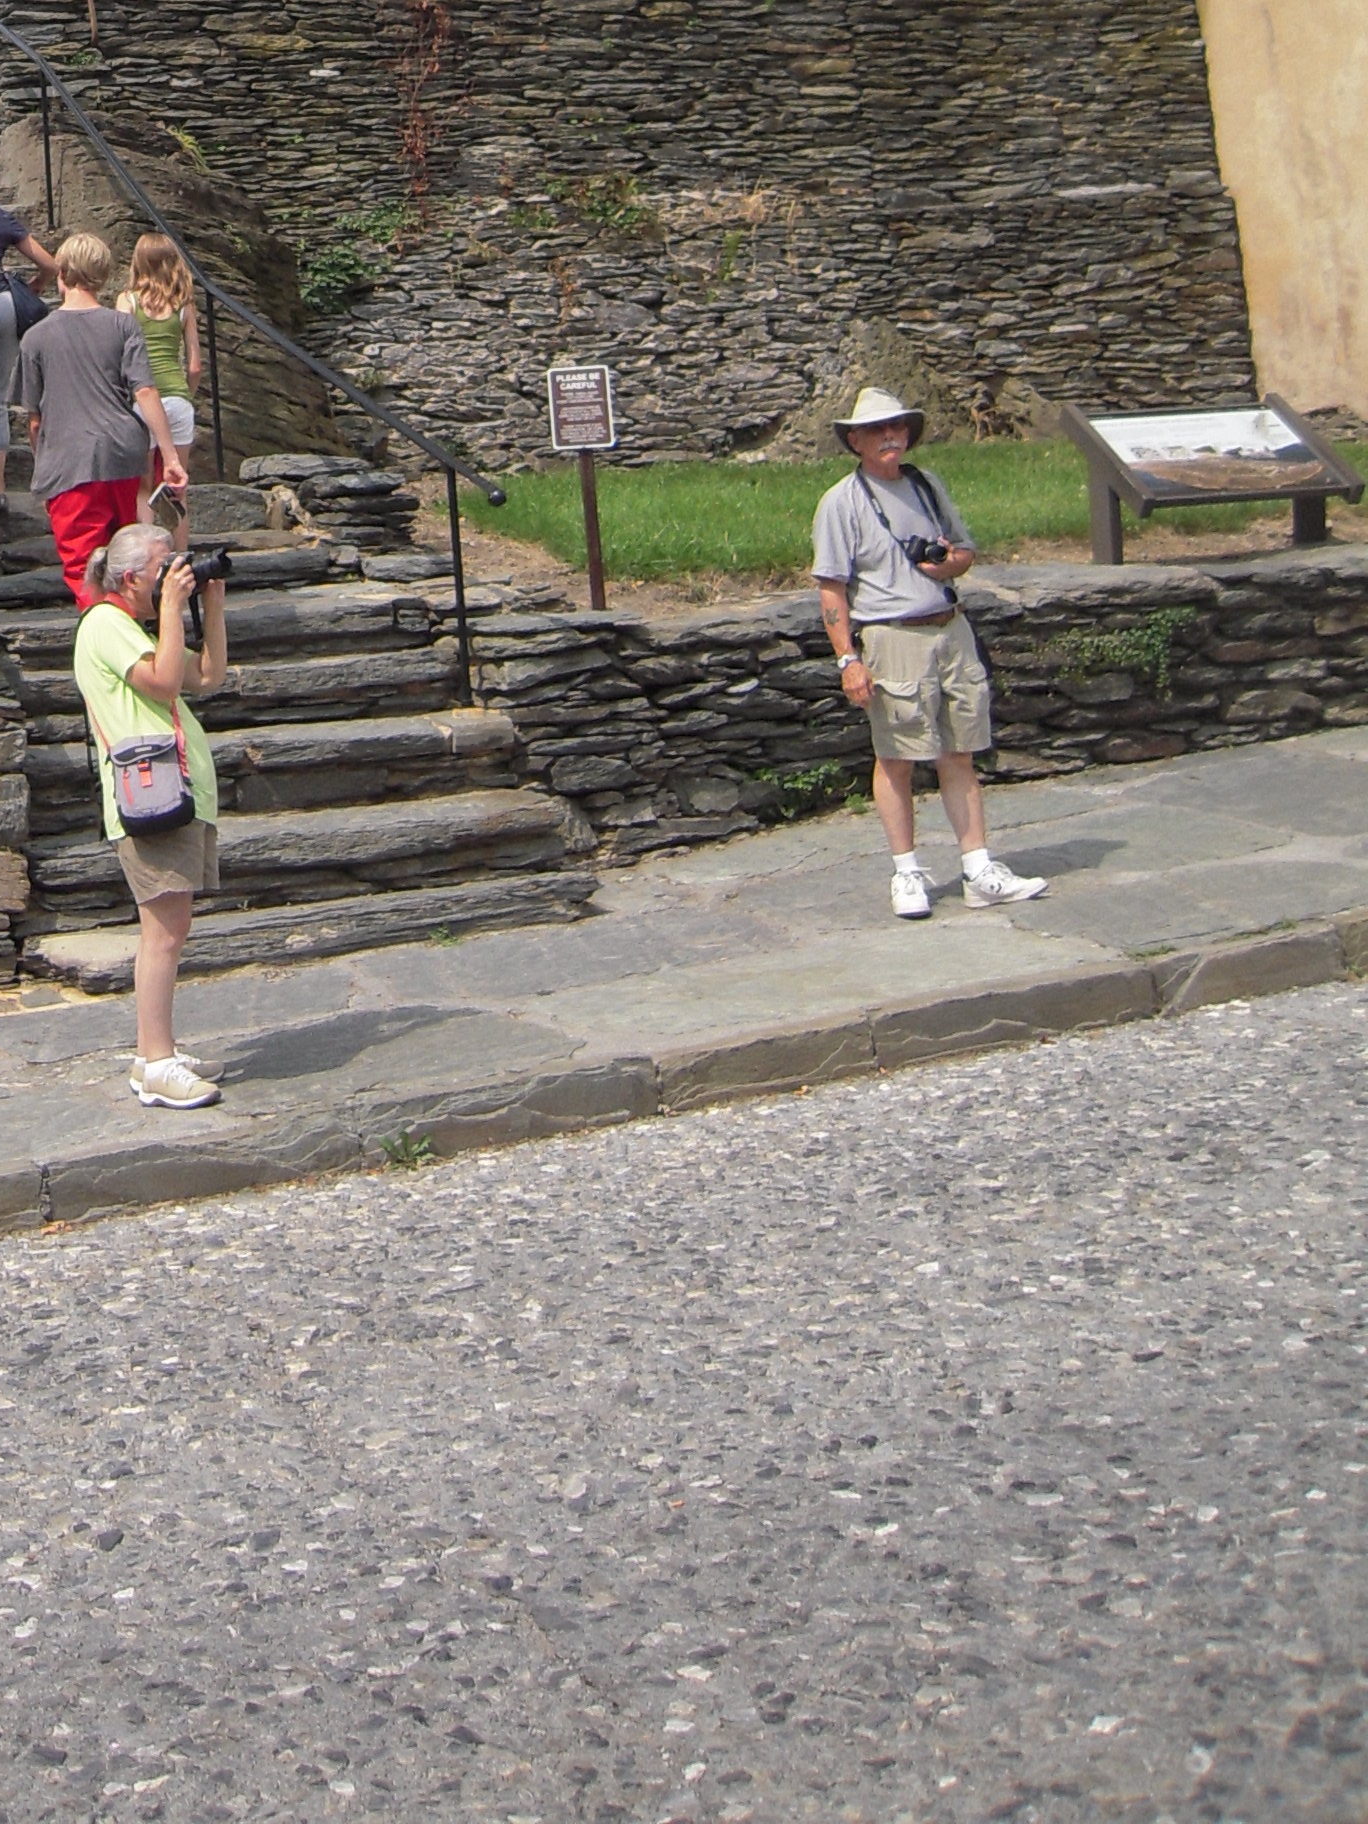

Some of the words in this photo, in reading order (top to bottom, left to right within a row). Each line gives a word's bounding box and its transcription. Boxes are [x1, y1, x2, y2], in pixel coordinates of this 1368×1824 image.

[555, 373, 587, 382] PLEASE
[588, 372, 601, 380] BE
[559, 381, 598, 390] CAREFUL
